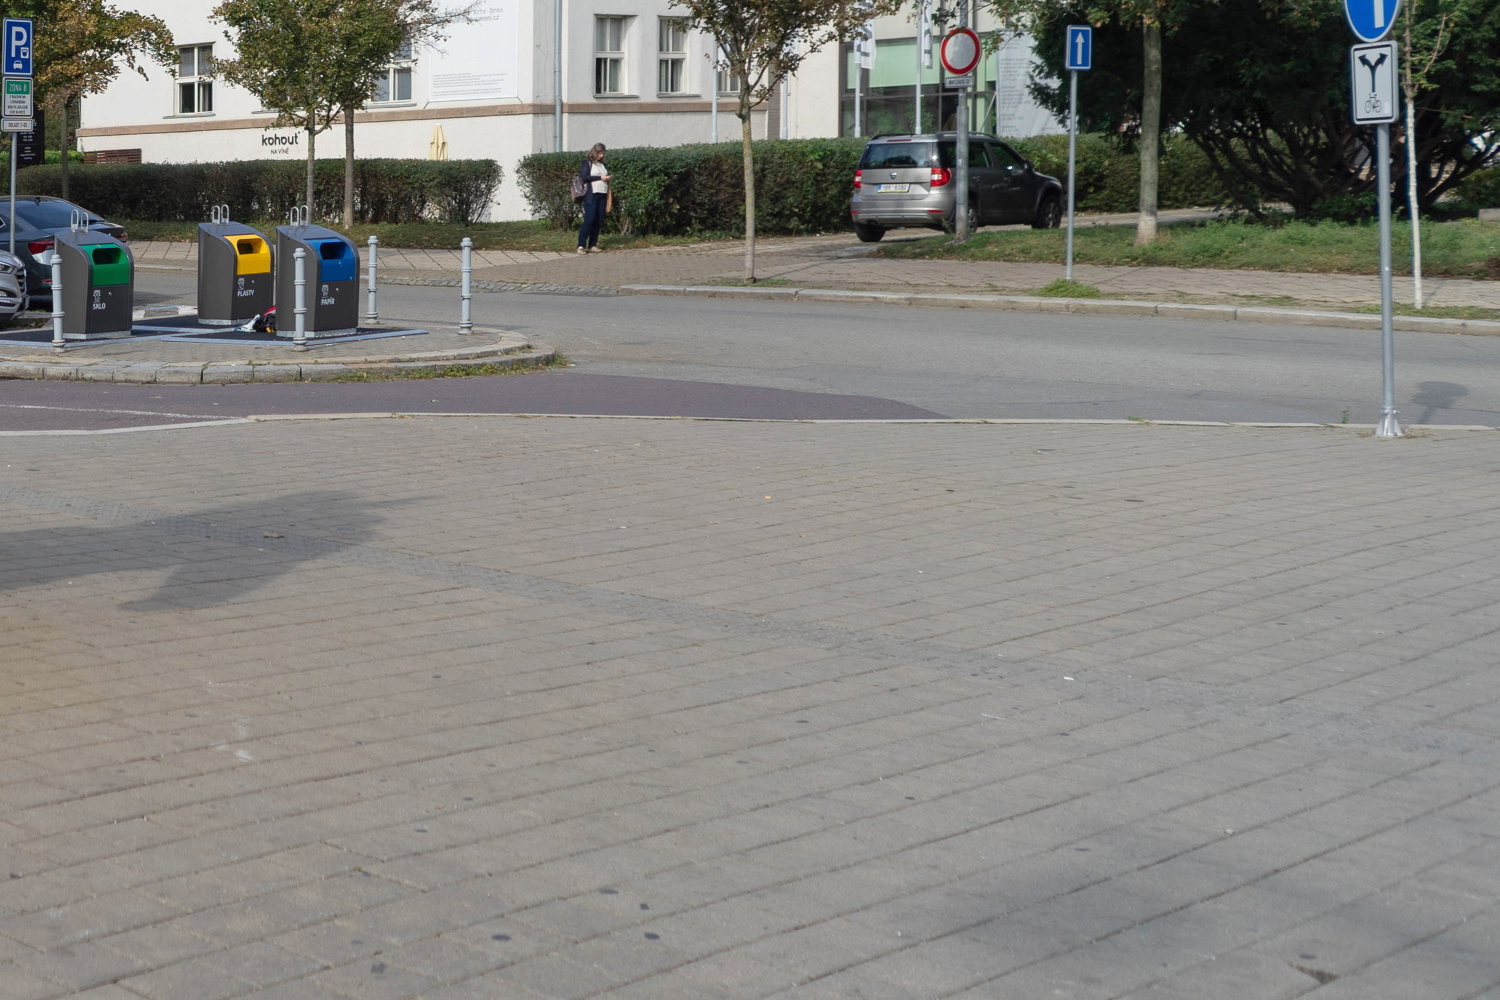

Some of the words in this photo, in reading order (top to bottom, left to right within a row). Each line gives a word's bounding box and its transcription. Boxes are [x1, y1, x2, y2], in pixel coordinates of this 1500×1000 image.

[11, 26, 28, 58] P
[261, 133, 299, 146] kohout
[237, 289, 255, 297] PLASTY
[320, 296, 335, 305] PAPÍR
[92, 302, 106, 310] SKLO
